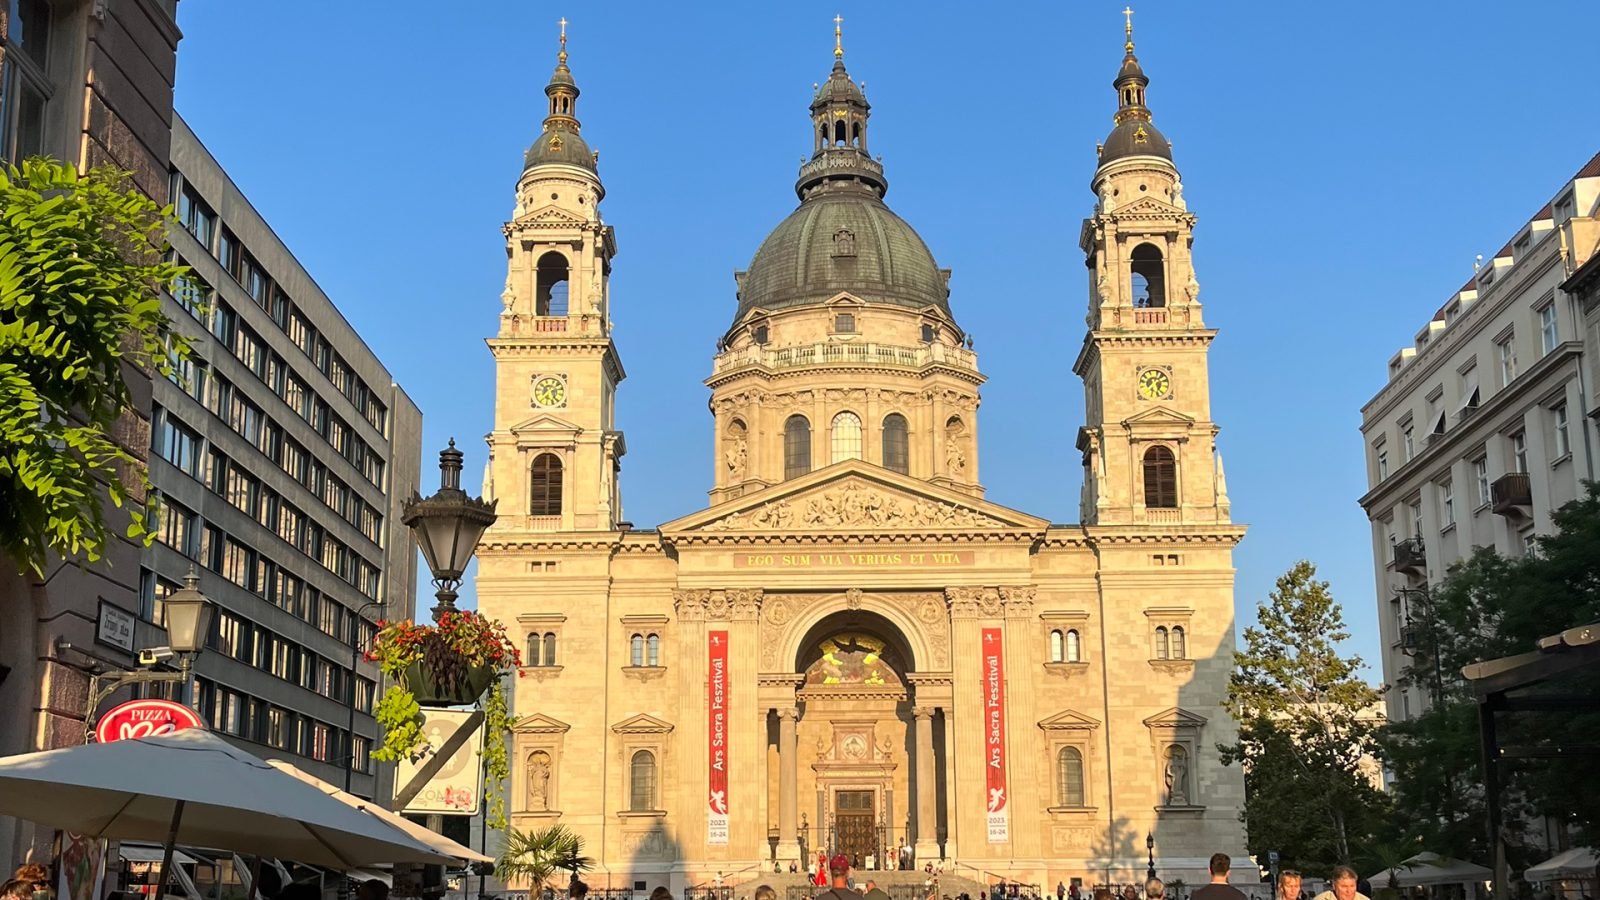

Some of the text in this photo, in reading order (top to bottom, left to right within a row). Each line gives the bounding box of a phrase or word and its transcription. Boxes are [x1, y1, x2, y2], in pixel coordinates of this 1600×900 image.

[747, 553, 960, 566] EGO SUM VIA VERITAS ET VITA
[131, 709, 171, 721] PIZZA
[713, 658, 723, 771] Ars Sacra Fesztivál
[987, 655, 1001, 769] Ars Sacra Fesztivál
